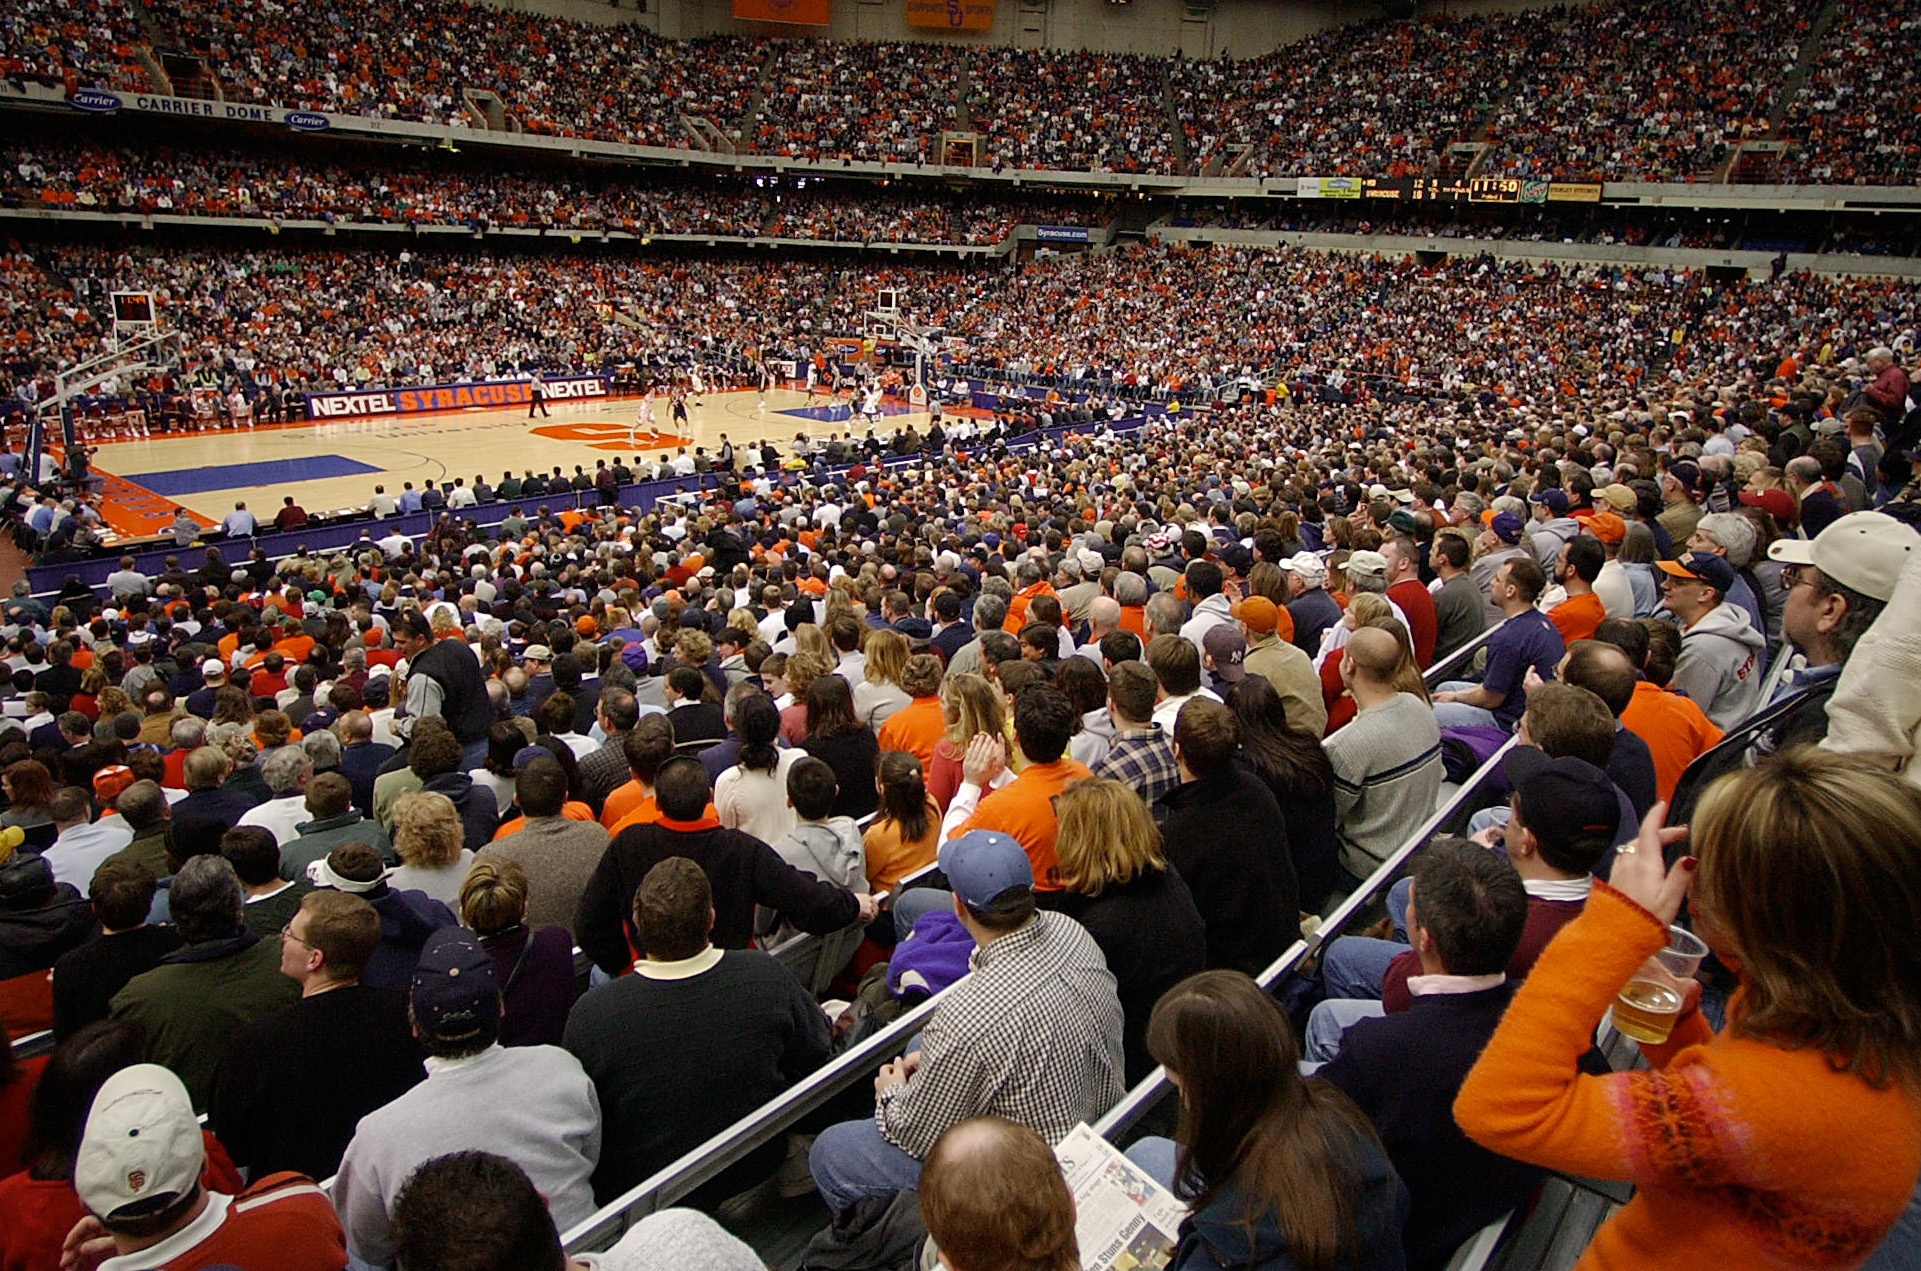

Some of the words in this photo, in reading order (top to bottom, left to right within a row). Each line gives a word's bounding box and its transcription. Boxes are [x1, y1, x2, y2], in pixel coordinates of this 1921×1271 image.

[73, 92, 115, 107] Carrier
[137, 97, 213, 115] CARRIER
[226, 106, 272, 121] DOME
[290, 115, 325, 127] Carrier
[541, 379, 606, 400] NEXTEL
[311, 394, 396, 417] NEXTEL
[1098, 1237, 1124, 1265] Stuns
[1119, 1212, 1147, 1240] Genny
